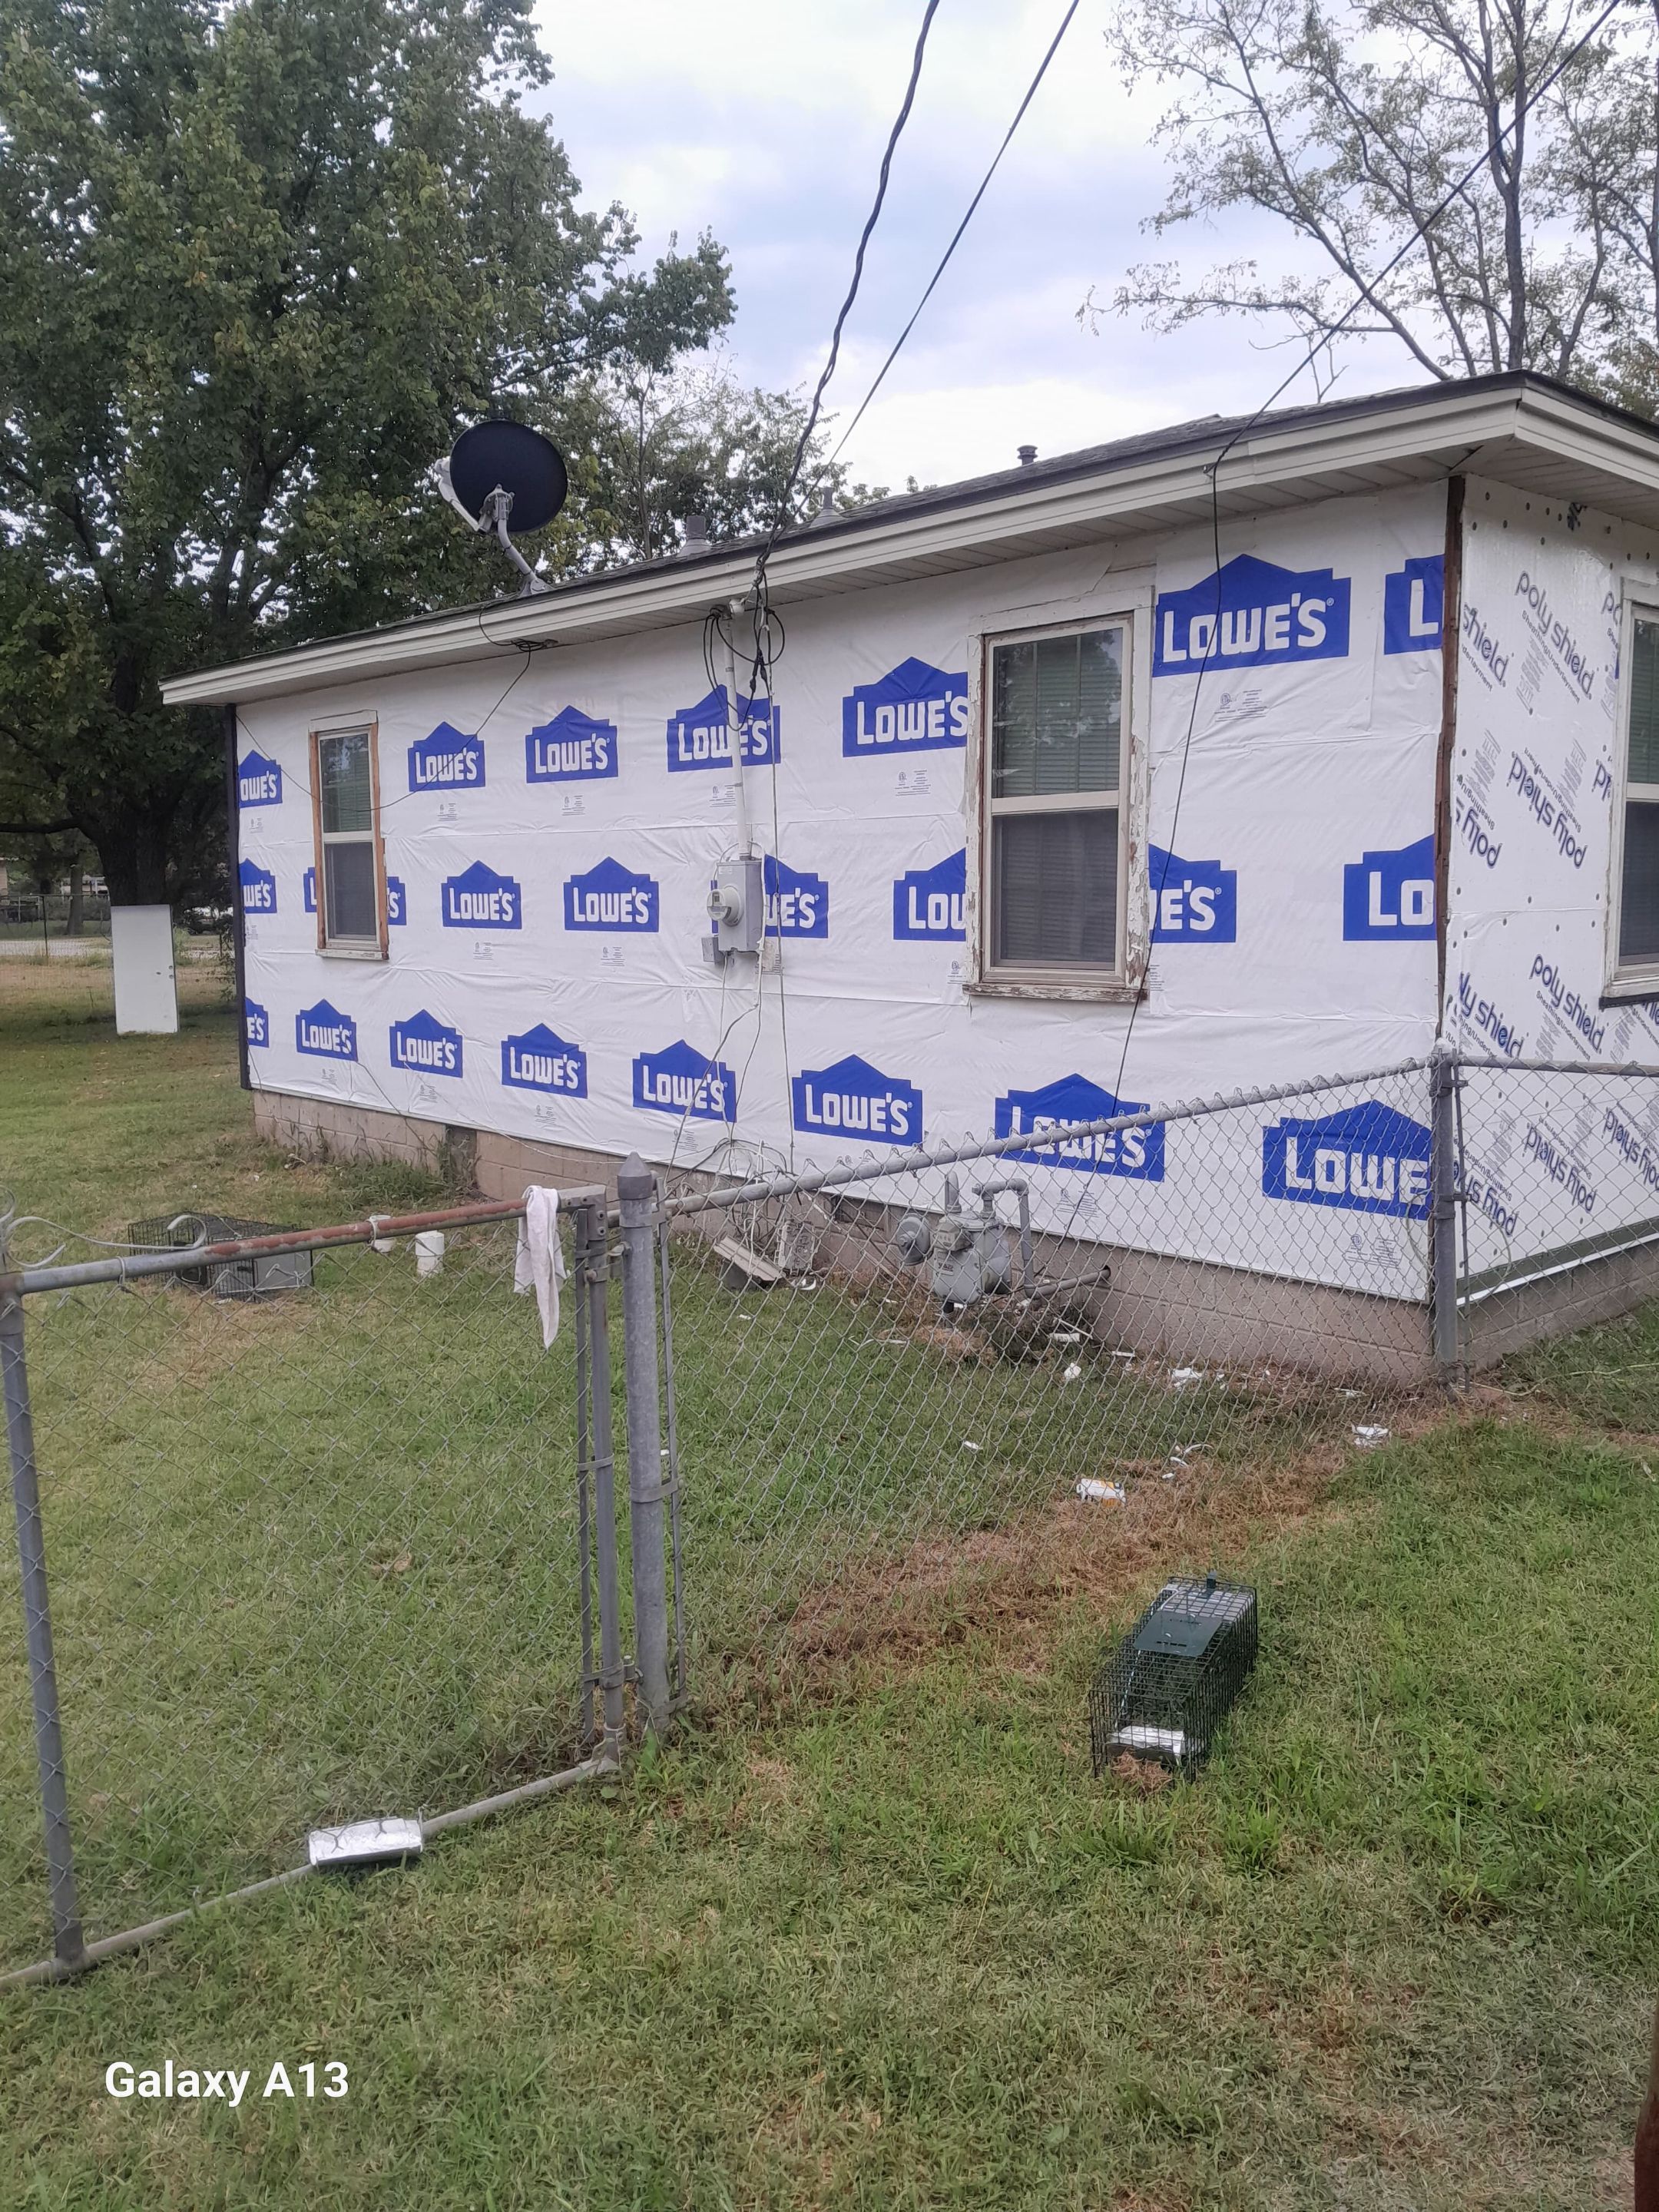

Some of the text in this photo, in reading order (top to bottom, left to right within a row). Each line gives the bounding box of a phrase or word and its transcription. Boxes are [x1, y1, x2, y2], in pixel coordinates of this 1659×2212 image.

[1163, 593, 1326, 663] LOWE'S
[1463, 604, 1510, 684] shield
[1515, 571, 1553, 635] poly
[1551, 621, 1595, 696] shield
[1462, 644, 1493, 691] derlayment
[856, 690, 969, 745] LOWE'S
[416, 747, 477, 783] LOWE'S
[535, 733, 608, 775] LOWE'S
[1462, 807, 1503, 869] poly
[1509, 756, 1555, 826] shield
[1553, 810, 1588, 869] poly
[449, 887, 514, 922] LOWE'S
[573, 886, 649, 924] LOWE'S
[1149, 879, 1216, 931] E'S
[1529, 954, 1565, 1009] poly
[1563, 992, 1605, 1053] shield
[301, 1019, 352, 1055] LOWE'S
[396, 1031, 455, 1069] LOWE'S
[510, 1046, 578, 1089] LOWE'S
[643, 1065, 725, 1113] LOWE'S
[805, 1084, 909, 1136] LOWE'S
[1012, 1106, 1146, 1168] LOWES
[1286, 1136, 1433, 1206] LOWE
